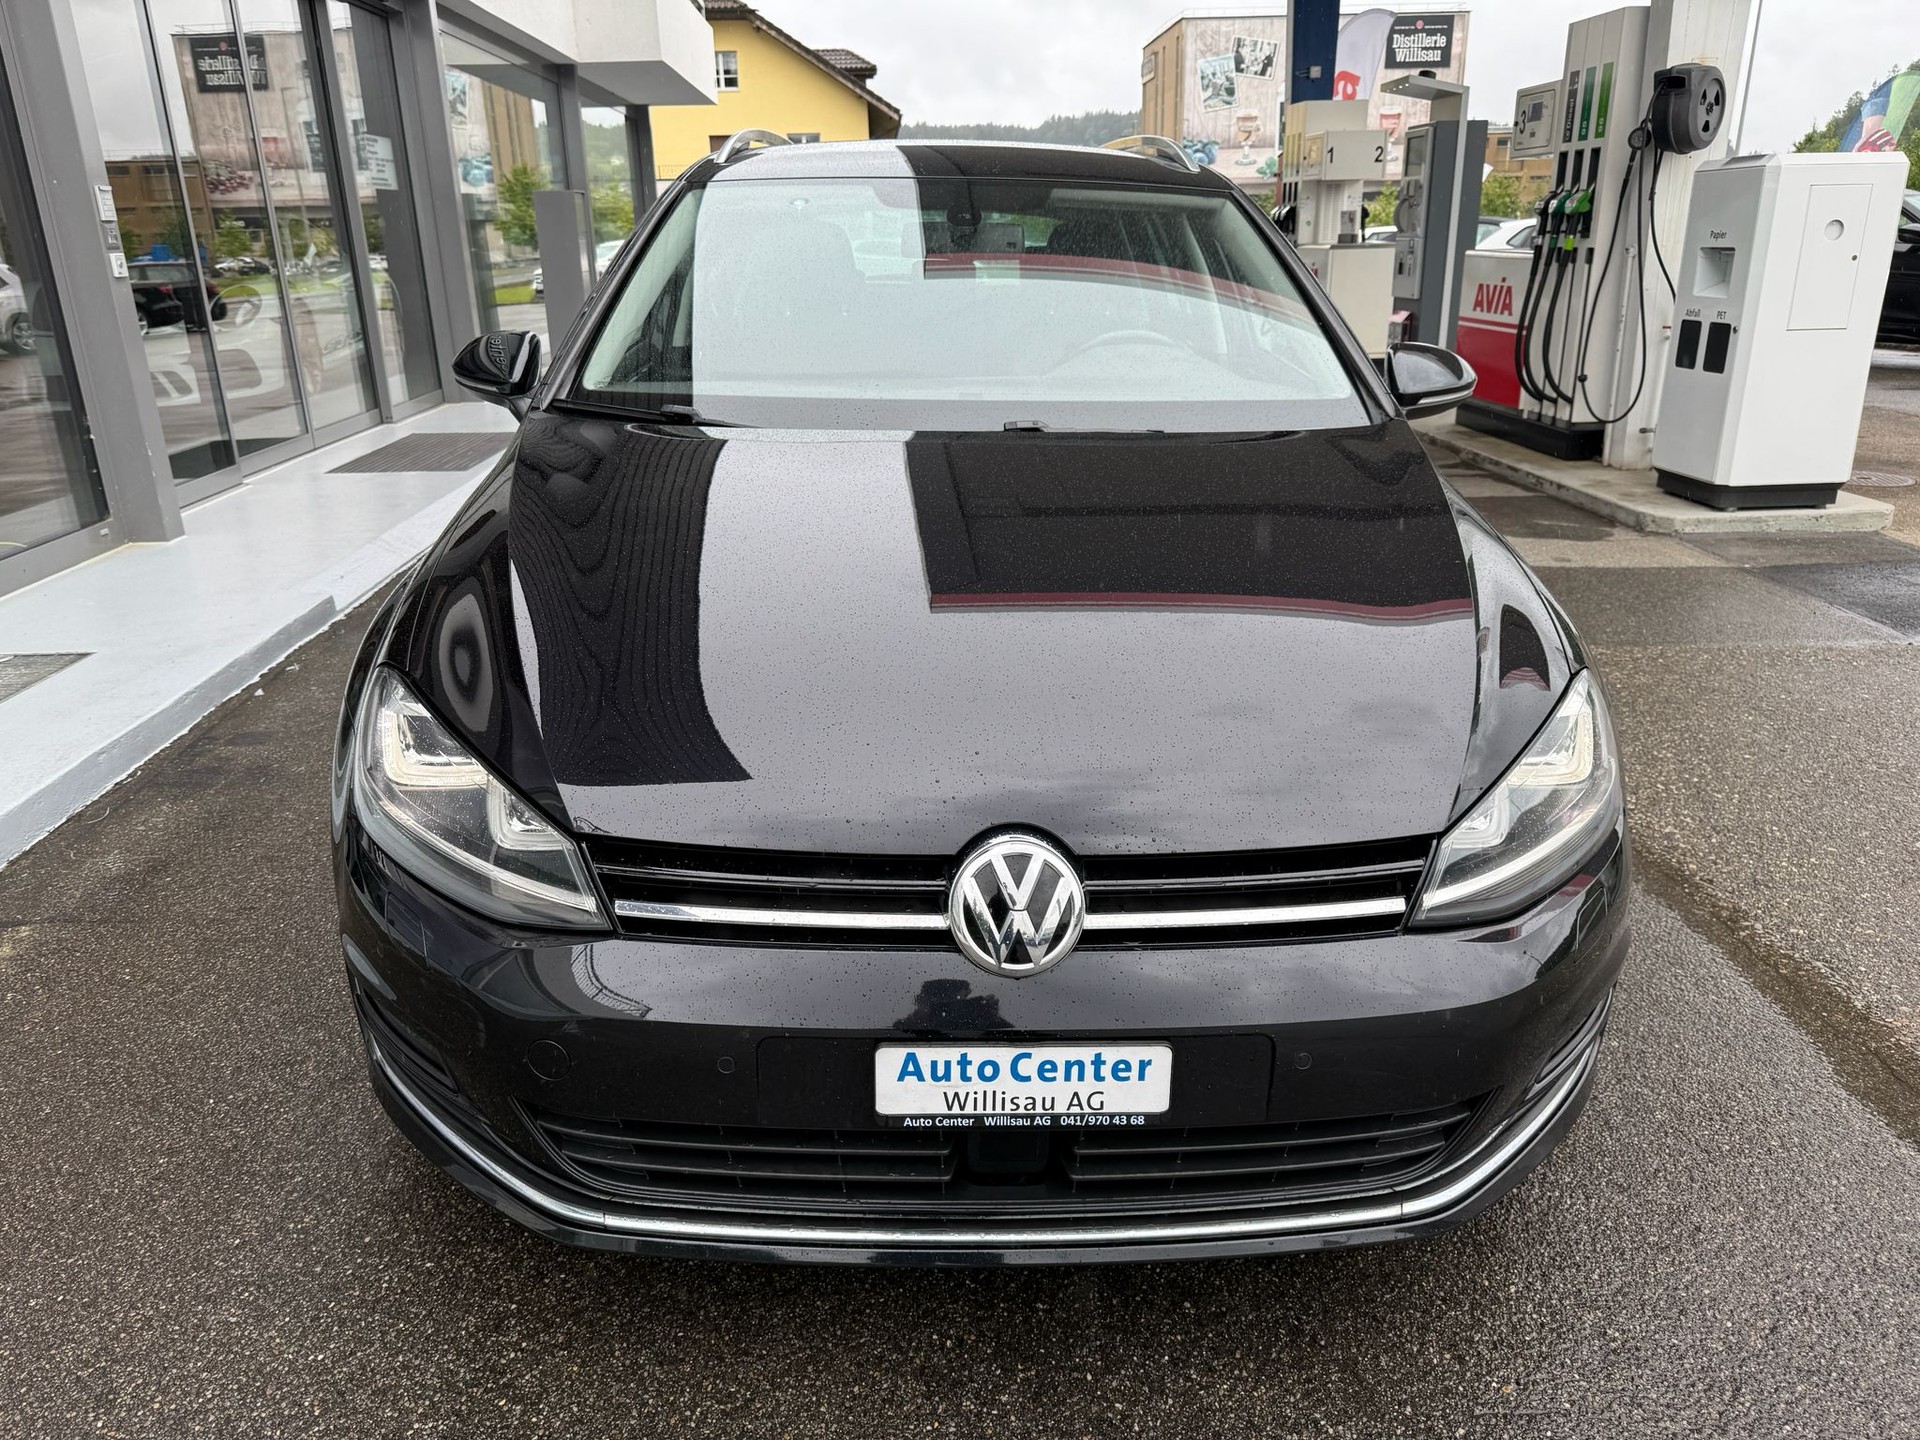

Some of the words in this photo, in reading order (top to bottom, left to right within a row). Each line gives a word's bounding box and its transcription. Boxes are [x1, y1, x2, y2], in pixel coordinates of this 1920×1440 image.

[1392, 33, 1447, 48] Distillerie
[1395, 47, 1442, 62] Willisau
[1519, 110, 1526, 134] 3
[1327, 146, 1334, 163] 1
[1374, 146, 1384, 163] 2
[1709, 230, 1727, 241] Papier
[1685, 308, 1701, 317] Abfall
[1716, 311, 1727, 320] PET
[897, 1052, 1000, 1082] Auto
[1010, 1052, 1153, 1083] Center
[943, 1090, 1055, 1112] Willisau
[1066, 1091, 1105, 1112] AG
[903, 1117, 932, 1127] Auto
[935, 1116, 975, 1127] Center
[984, 1116, 1030, 1126] Willisau
[1033, 1116, 1051, 1126] AG
[1060, 1114, 1110, 1127] 041/970
[1113, 1116, 1127, 1126] 43
[1130, 1115, 1145, 1126] 68
